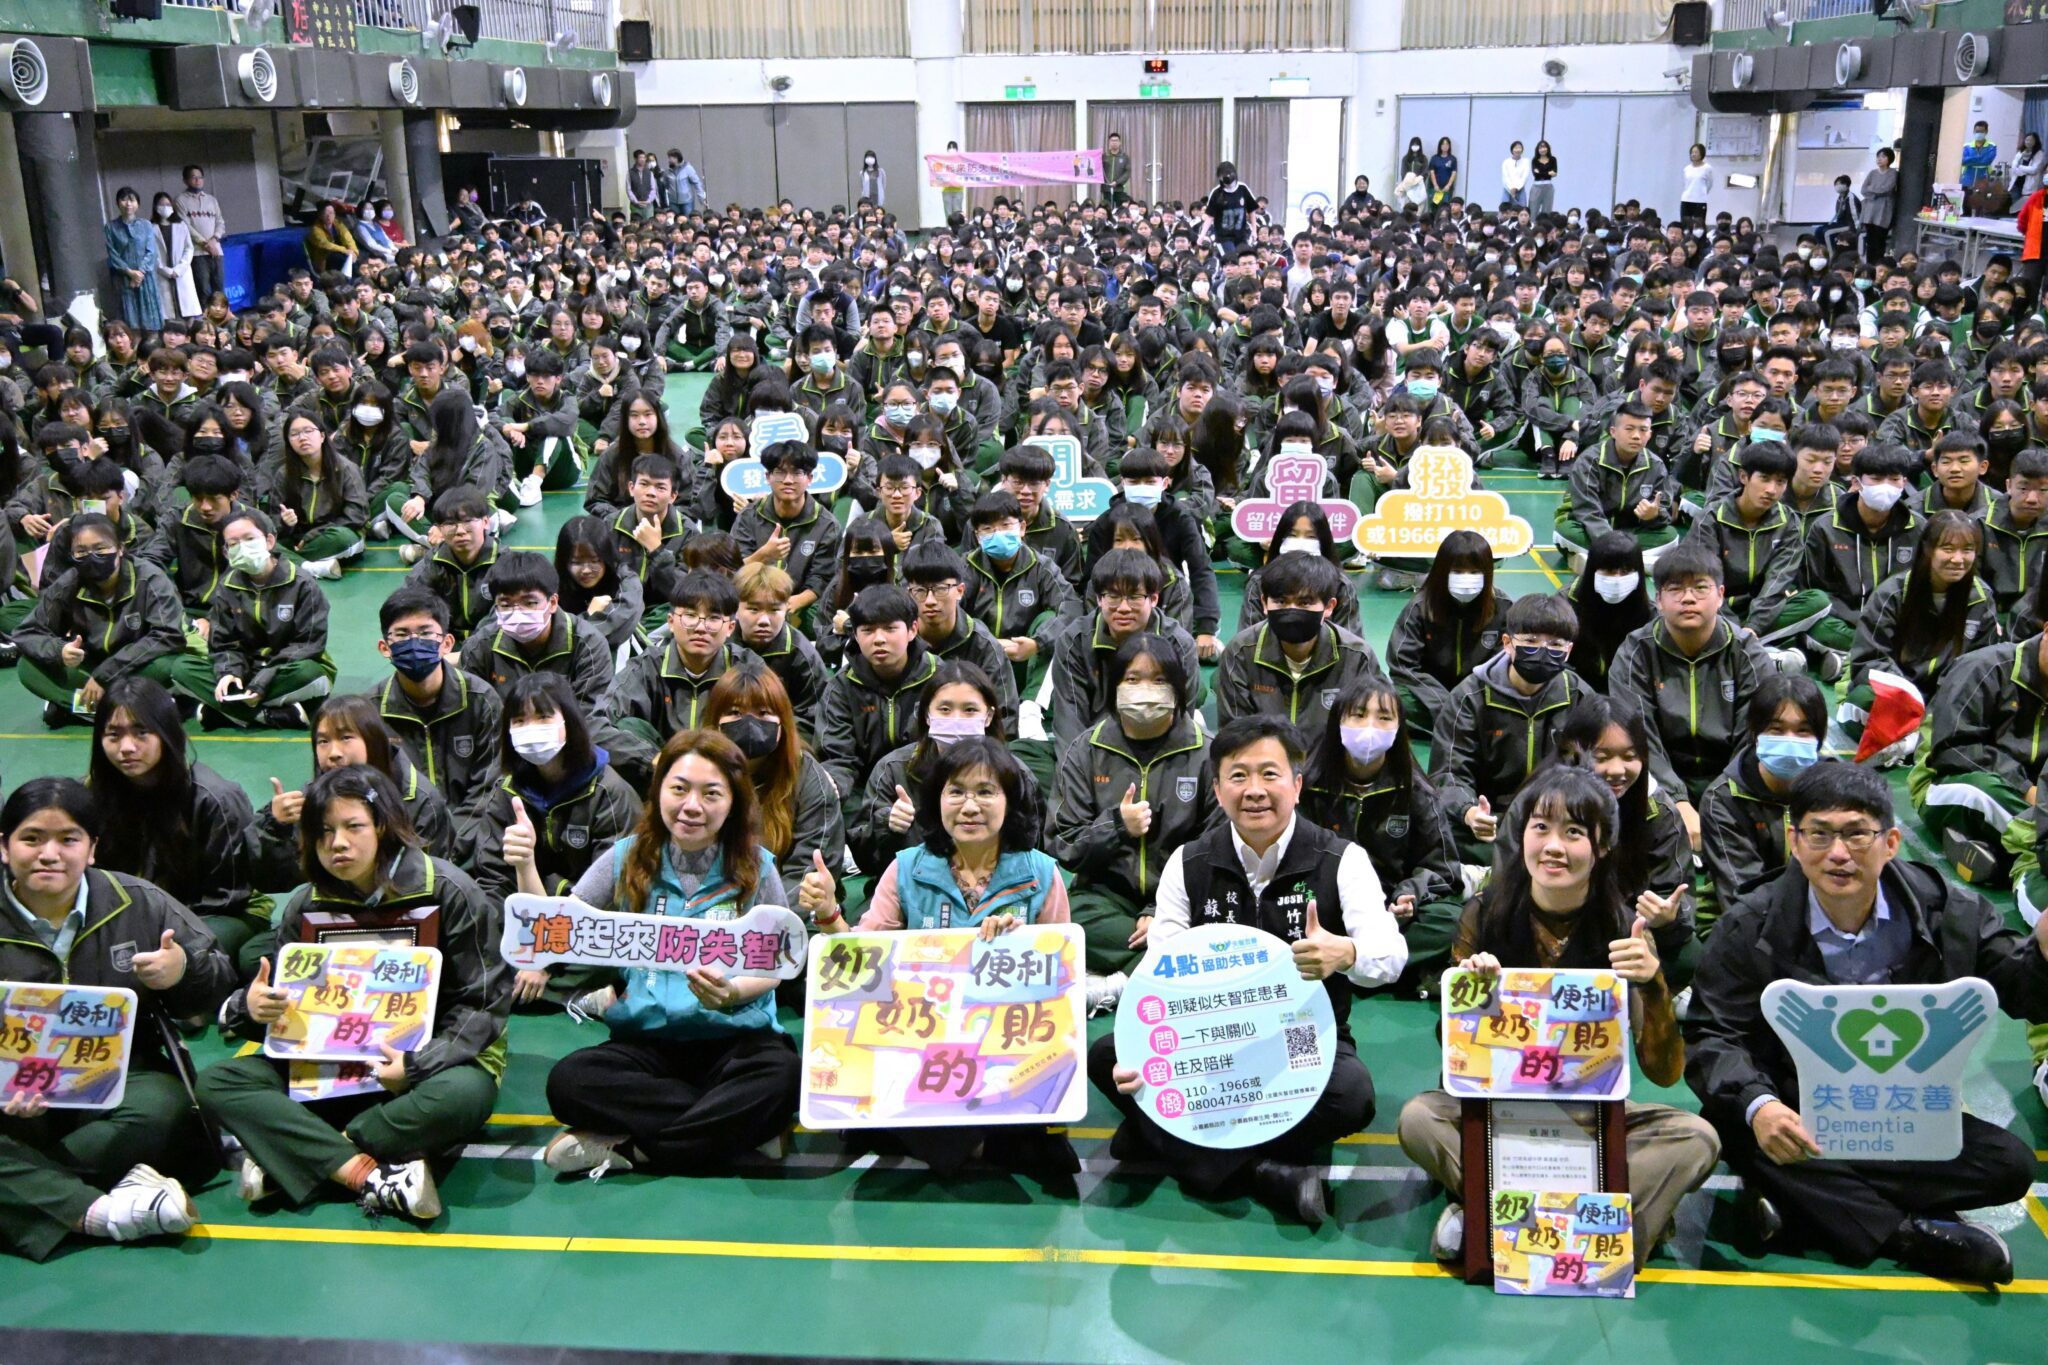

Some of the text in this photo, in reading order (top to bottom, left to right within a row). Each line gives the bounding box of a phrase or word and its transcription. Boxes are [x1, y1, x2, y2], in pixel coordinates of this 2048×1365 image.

[1275, 460, 1319, 505] 留
[1418, 454, 1464, 497] 撥
[1403, 502, 1482, 522] 撥打110
[1203, 898, 1222, 925] 蘇
[1225, 890, 1240, 924] 校長
[531, 911, 779, 971] 憶起來防失智
[284, 949, 325, 981] 奶
[372, 958, 421, 984] 便利
[819, 942, 884, 993] 奶
[971, 948, 1051, 988] 便利
[1153, 949, 1270, 979] 4點 協助失智者
[314, 978, 349, 1010] 奶
[385, 992, 418, 1019] 貼
[1142, 1000, 1164, 1021] 看
[1168, 983, 1289, 1017] 到疑似失智症患者
[1450, 974, 1493, 1010] 奶
[1552, 983, 1606, 1012] 便利
[60, 1001, 116, 1028] 便利
[876, 991, 937, 1039] 奶
[1001, 1000, 1057, 1050] 貼
[1489, 1008, 1531, 1042] 奶
[333, 1017, 370, 1045] 的
[1155, 1021, 1257, 1051] 問 一下與關心
[1574, 1021, 1610, 1052] 貼
[73, 1036, 111, 1064] 貼
[14, 1061, 56, 1091] 的
[917, 1050, 978, 1098] 的
[1148, 1053, 1235, 1084] 留 住及陪伴
[1520, 1050, 1559, 1082] 的
[1161, 1093, 1182, 1114] 撥
[1187, 1090, 1264, 1112] 0800474580
[1812, 1083, 1953, 1112] 失智友善
[1816, 1116, 1915, 1134] Dementia
[1815, 1134, 1895, 1153] Friends
[1495, 1194, 1530, 1223] 奶
[1577, 1202, 1621, 1226] 便利
[1528, 1223, 1560, 1250] 奶
[1595, 1233, 1624, 1258] 貼
[1552, 1256, 1584, 1284] 的
